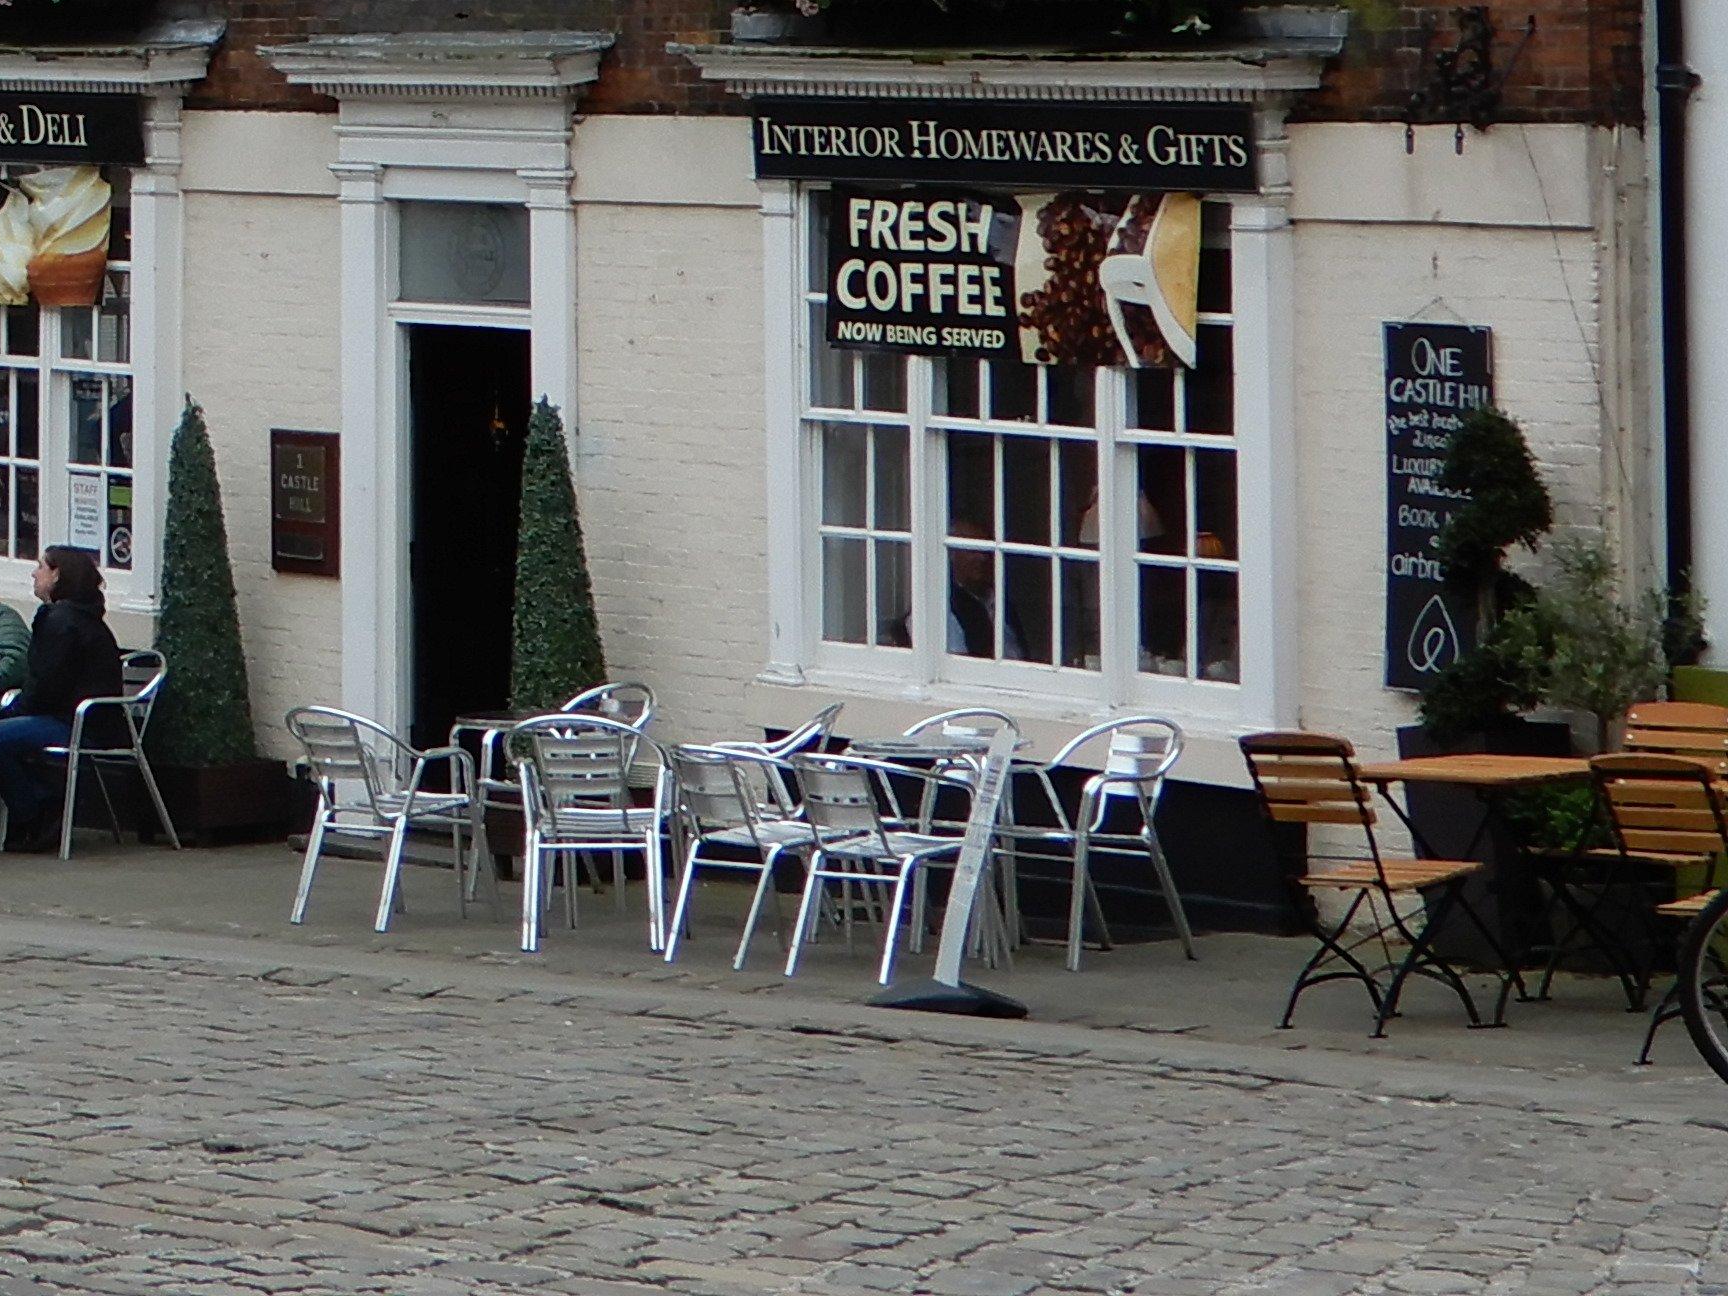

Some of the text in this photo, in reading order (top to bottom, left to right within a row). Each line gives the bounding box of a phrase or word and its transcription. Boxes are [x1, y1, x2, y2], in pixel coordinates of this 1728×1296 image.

[1117, 133, 1143, 165] &
[849, 198, 994, 254] FRESH
[837, 258, 1007, 317] COFFEE
[837, 321, 1006, 349] NOW BEING SERVED
[1410, 336, 1464, 377] ONE
[1389, 376, 1457, 407] CASTLE
[281, 473, 319, 492] CASTLE
